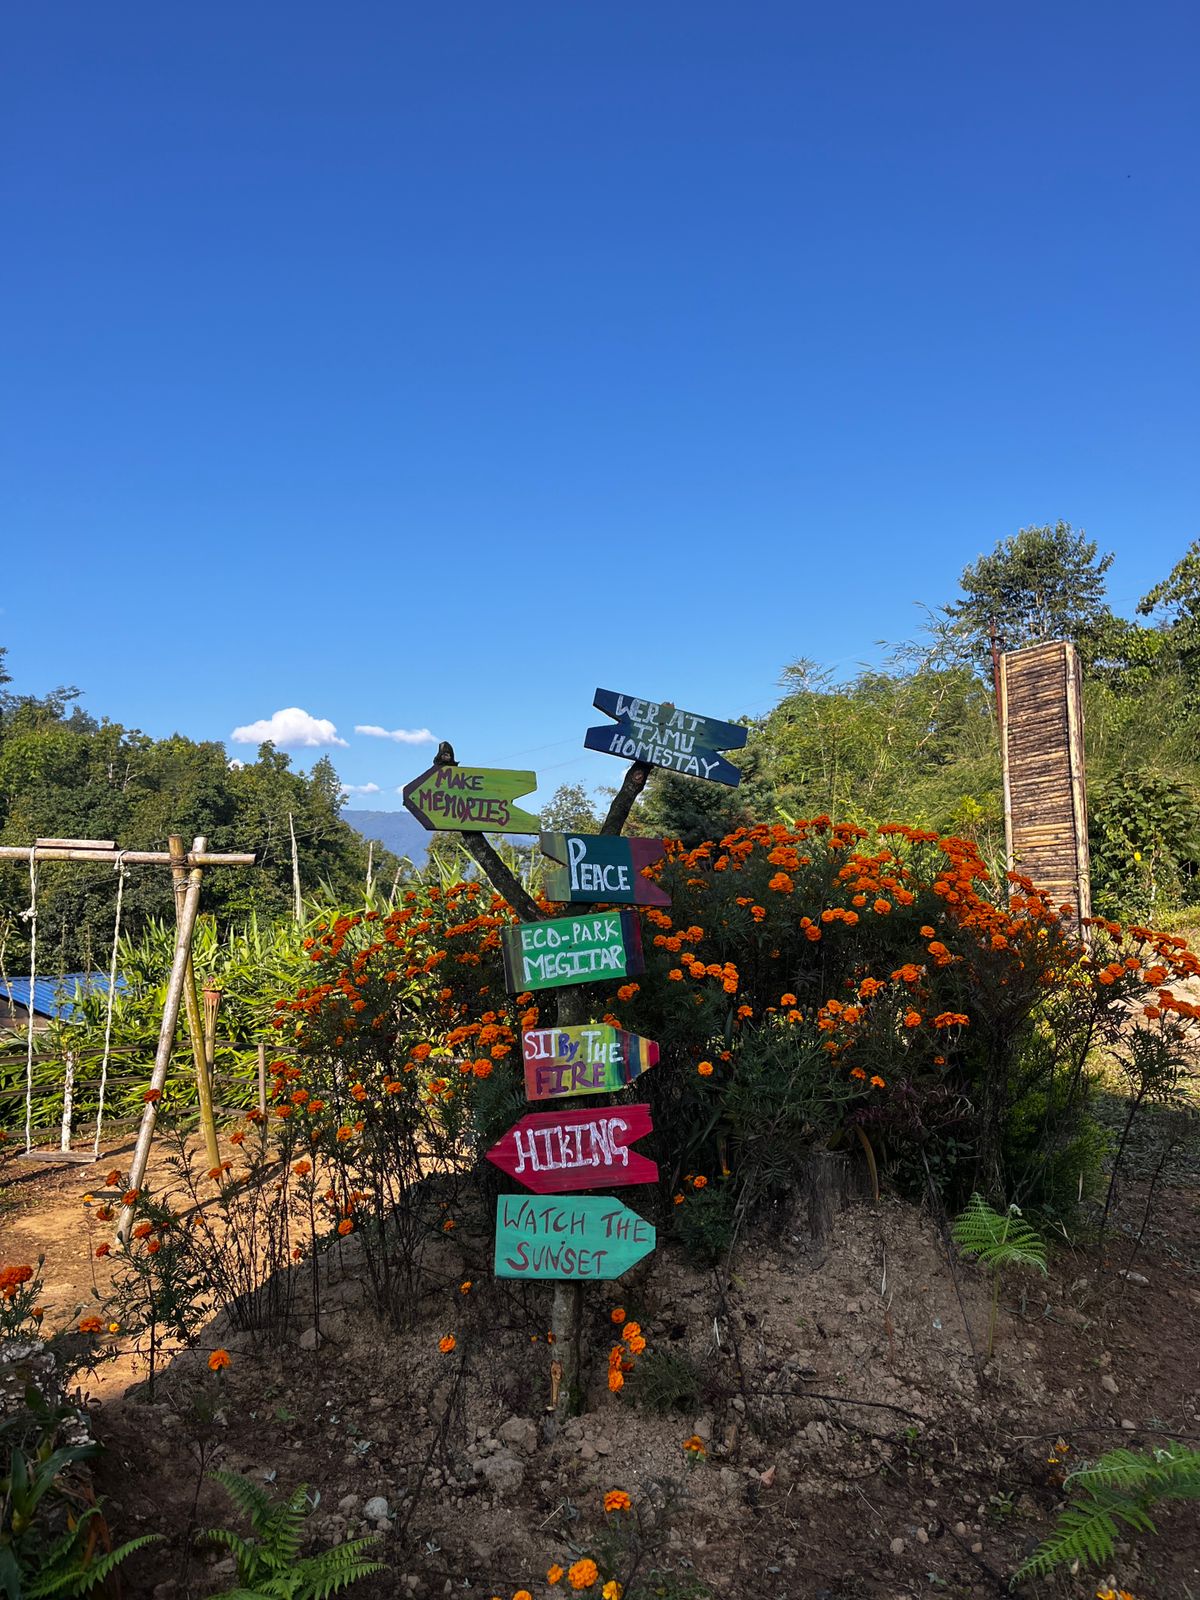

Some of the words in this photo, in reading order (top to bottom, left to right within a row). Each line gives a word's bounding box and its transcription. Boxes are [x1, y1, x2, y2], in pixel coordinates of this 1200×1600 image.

[633, 722, 696, 753] TAMU
[666, 709, 706, 732] AT
[609, 733, 720, 779] HOMESTAY
[435, 767, 485, 791] MAKE
[418, 788, 510, 826] MEMORIES
[567, 837, 631, 892] PEACE
[520, 919, 619, 950] ECO-PARK
[521, 944, 625, 984] MEGITAR
[524, 1029, 561, 1060] SIT
[581, 1030, 624, 1063] THE
[535, 1061, 606, 1095] FIRE
[513, 1118, 629, 1174] HIKING
[503, 1199, 587, 1236] WATCH
[601, 1210, 649, 1243] THE
[505, 1241, 609, 1276] SUNSET
